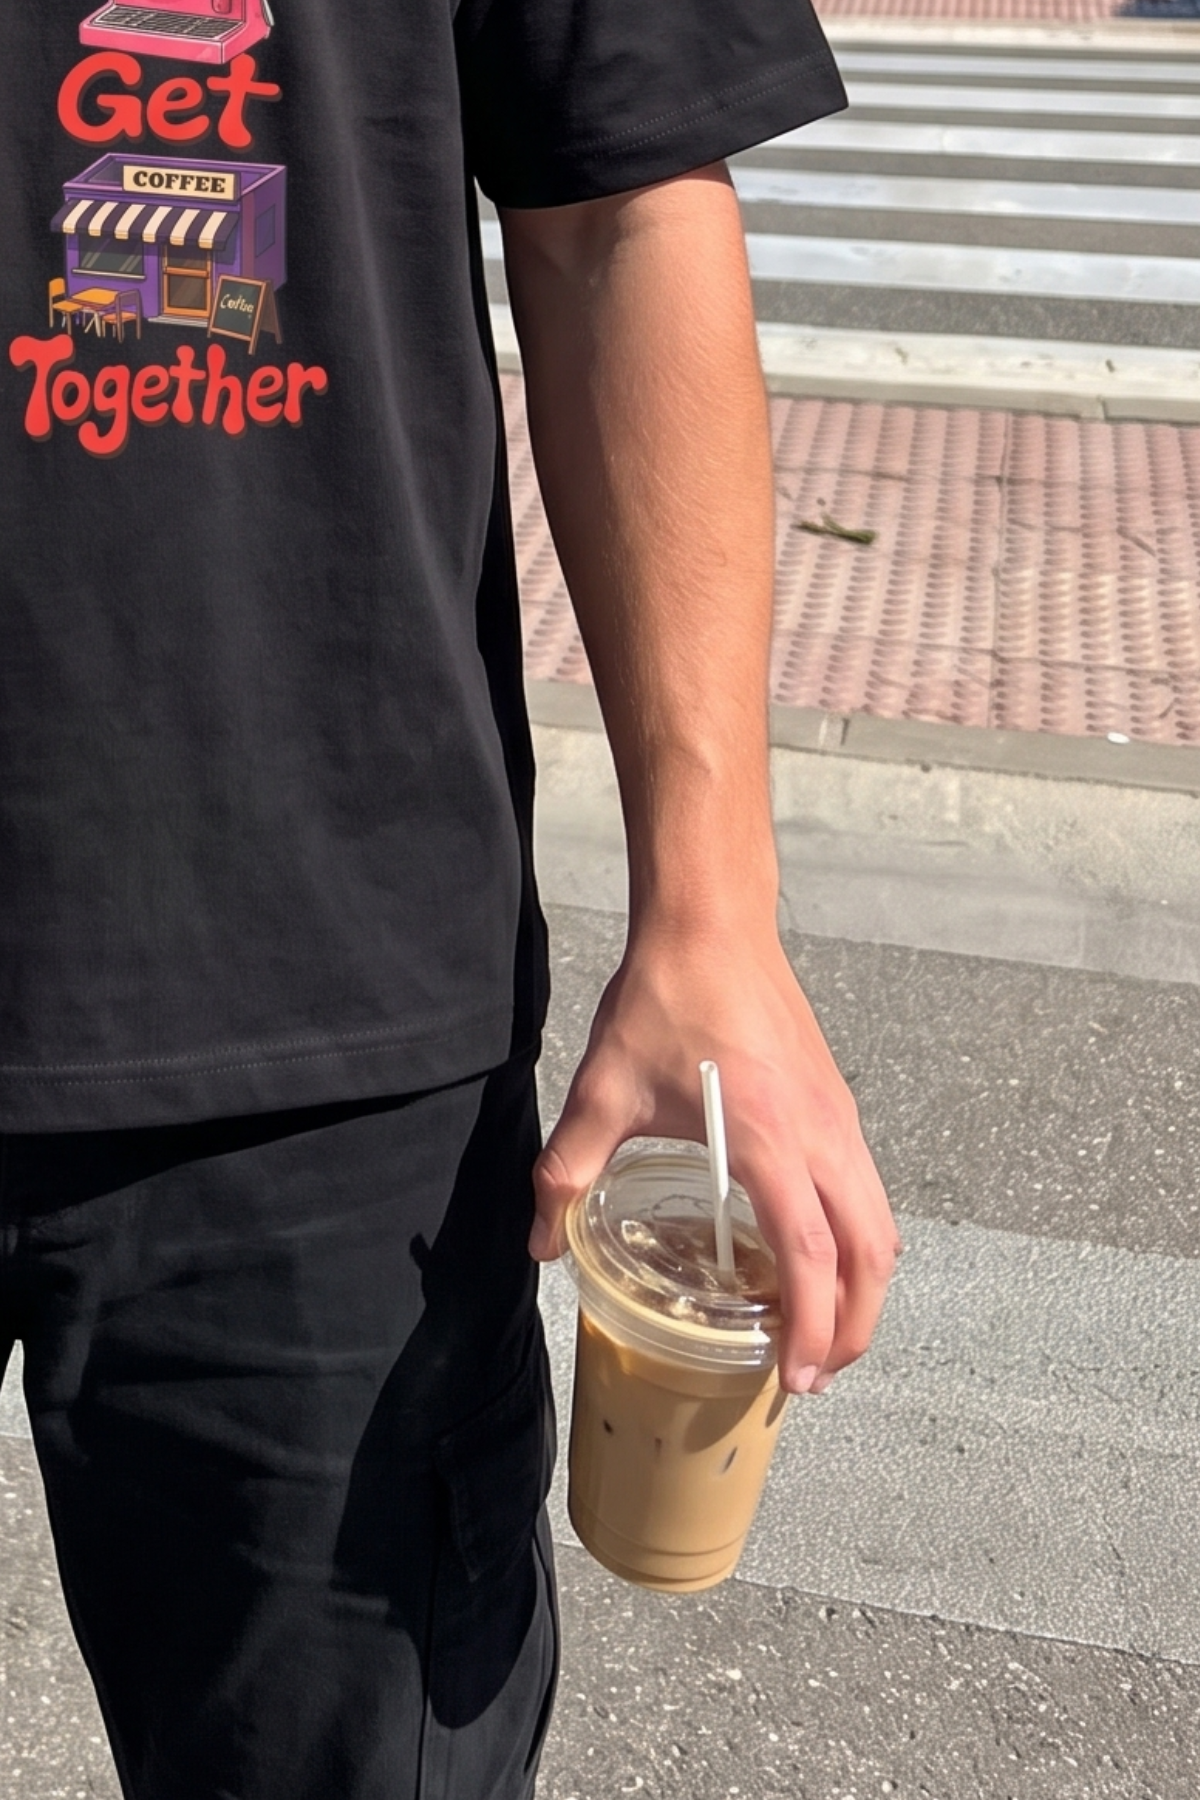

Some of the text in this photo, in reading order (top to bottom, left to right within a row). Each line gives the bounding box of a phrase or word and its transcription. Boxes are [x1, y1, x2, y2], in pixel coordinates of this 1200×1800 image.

[57, 51, 280, 148] Get
[132, 170, 227, 194] COFFEE
[8, 333, 328, 455] Together
